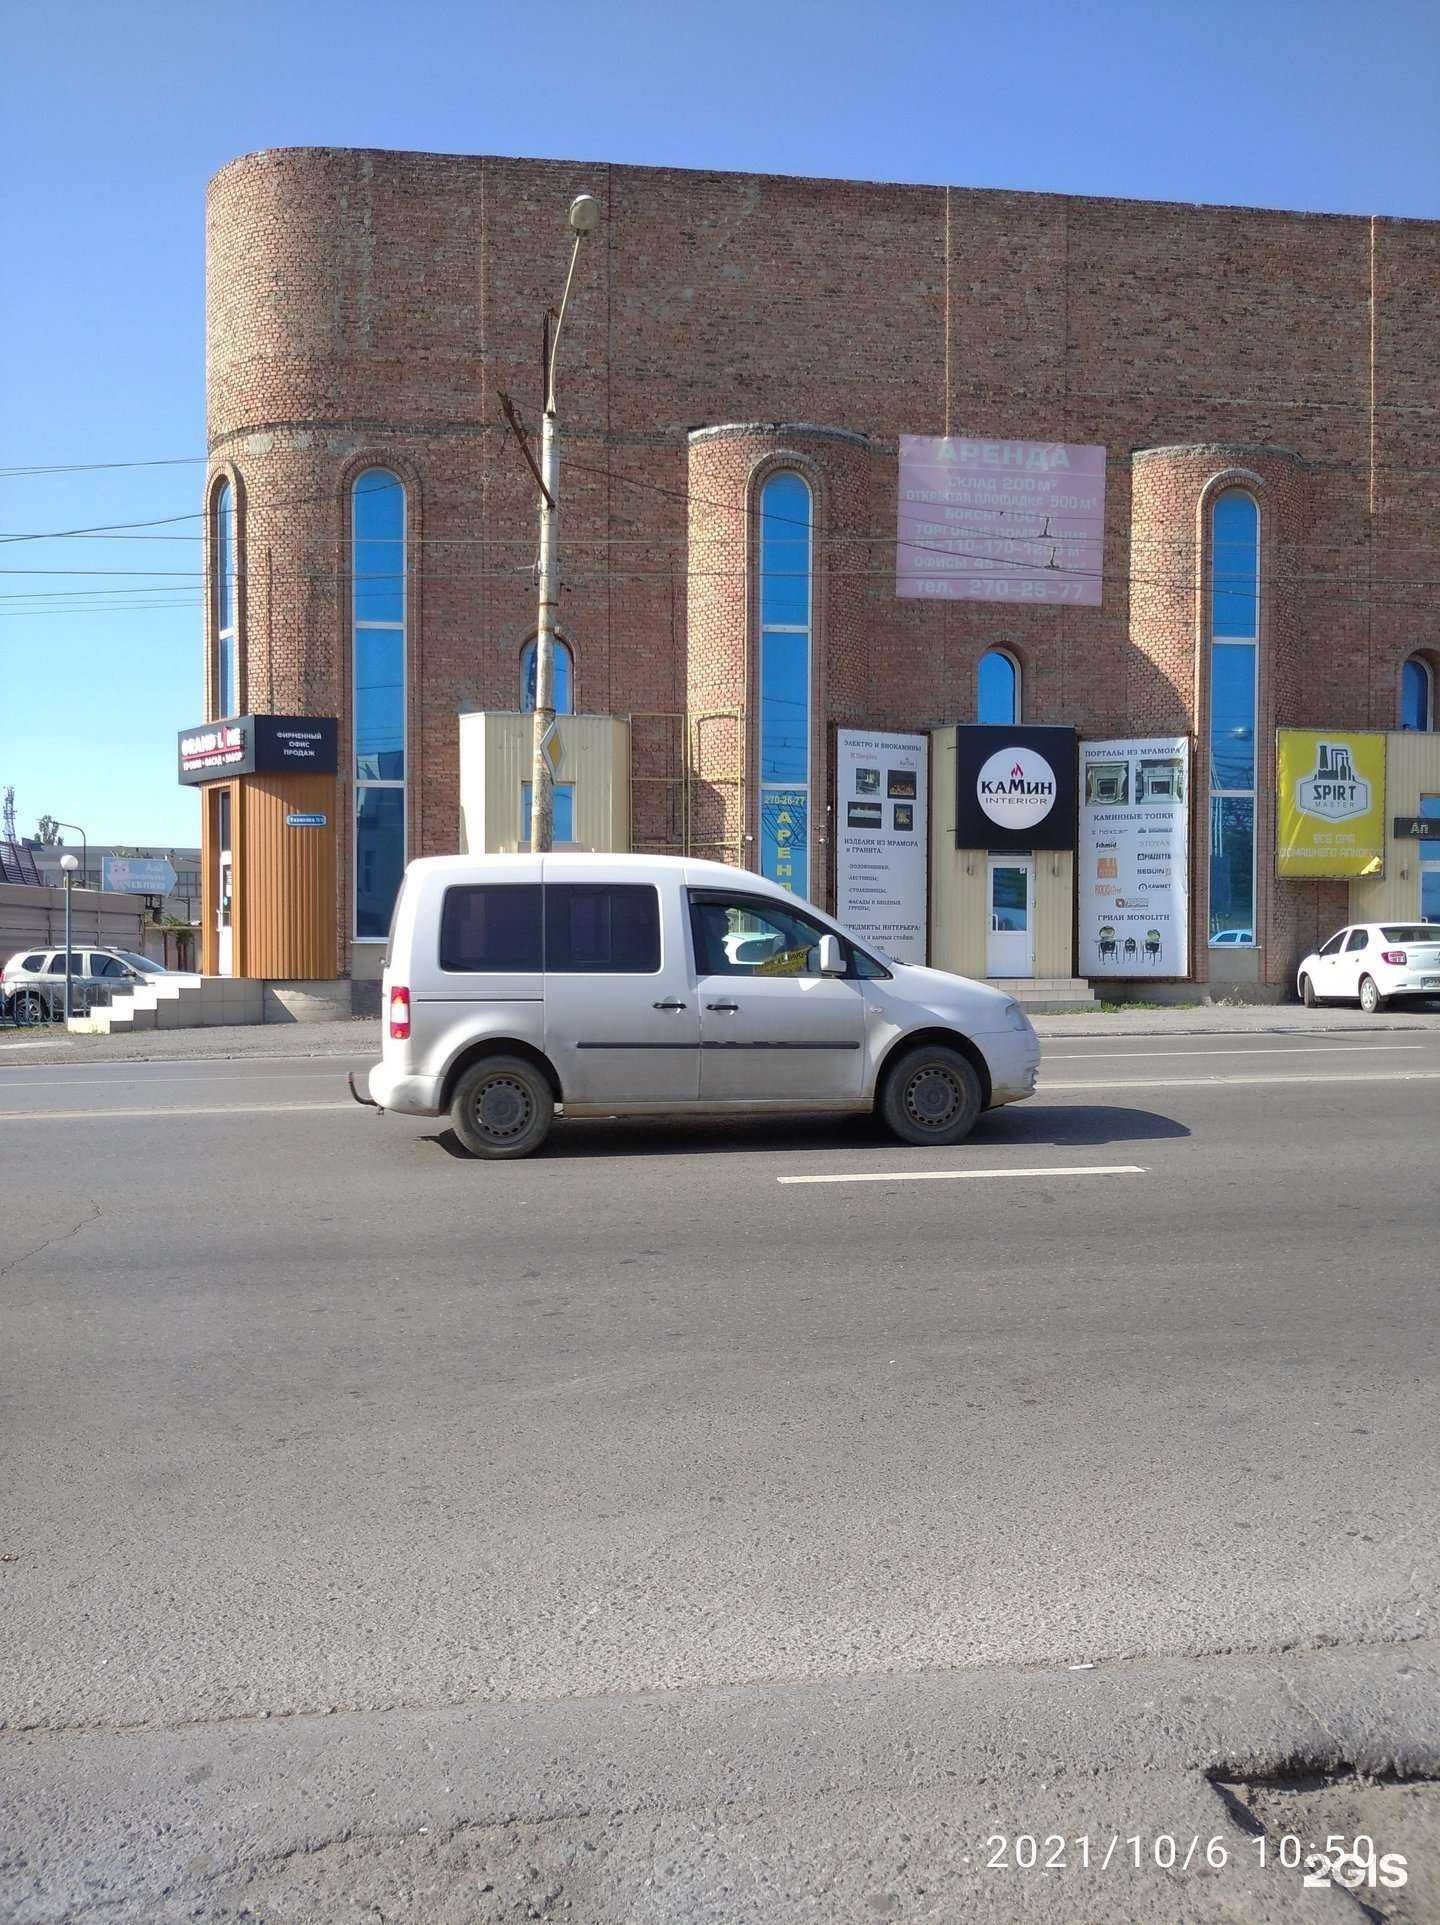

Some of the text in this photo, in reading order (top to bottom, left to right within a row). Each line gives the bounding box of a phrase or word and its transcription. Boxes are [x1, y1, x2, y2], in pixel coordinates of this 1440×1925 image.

[936, 441, 1070, 470] АРЕНДА
[276, 732, 322, 740] ФИРМЕННЫЙ
[844, 740, 873, 748] ЭЛЕКТРО
[1140, 747, 1181, 756] МРАМОРА
[1313, 785, 1356, 800] SPIRT
[986, 797, 1048, 805] INTERIOR
[844, 838, 875, 846] ИЗДЕЛИЯ
[887, 840, 919, 848] МРАМОРА
